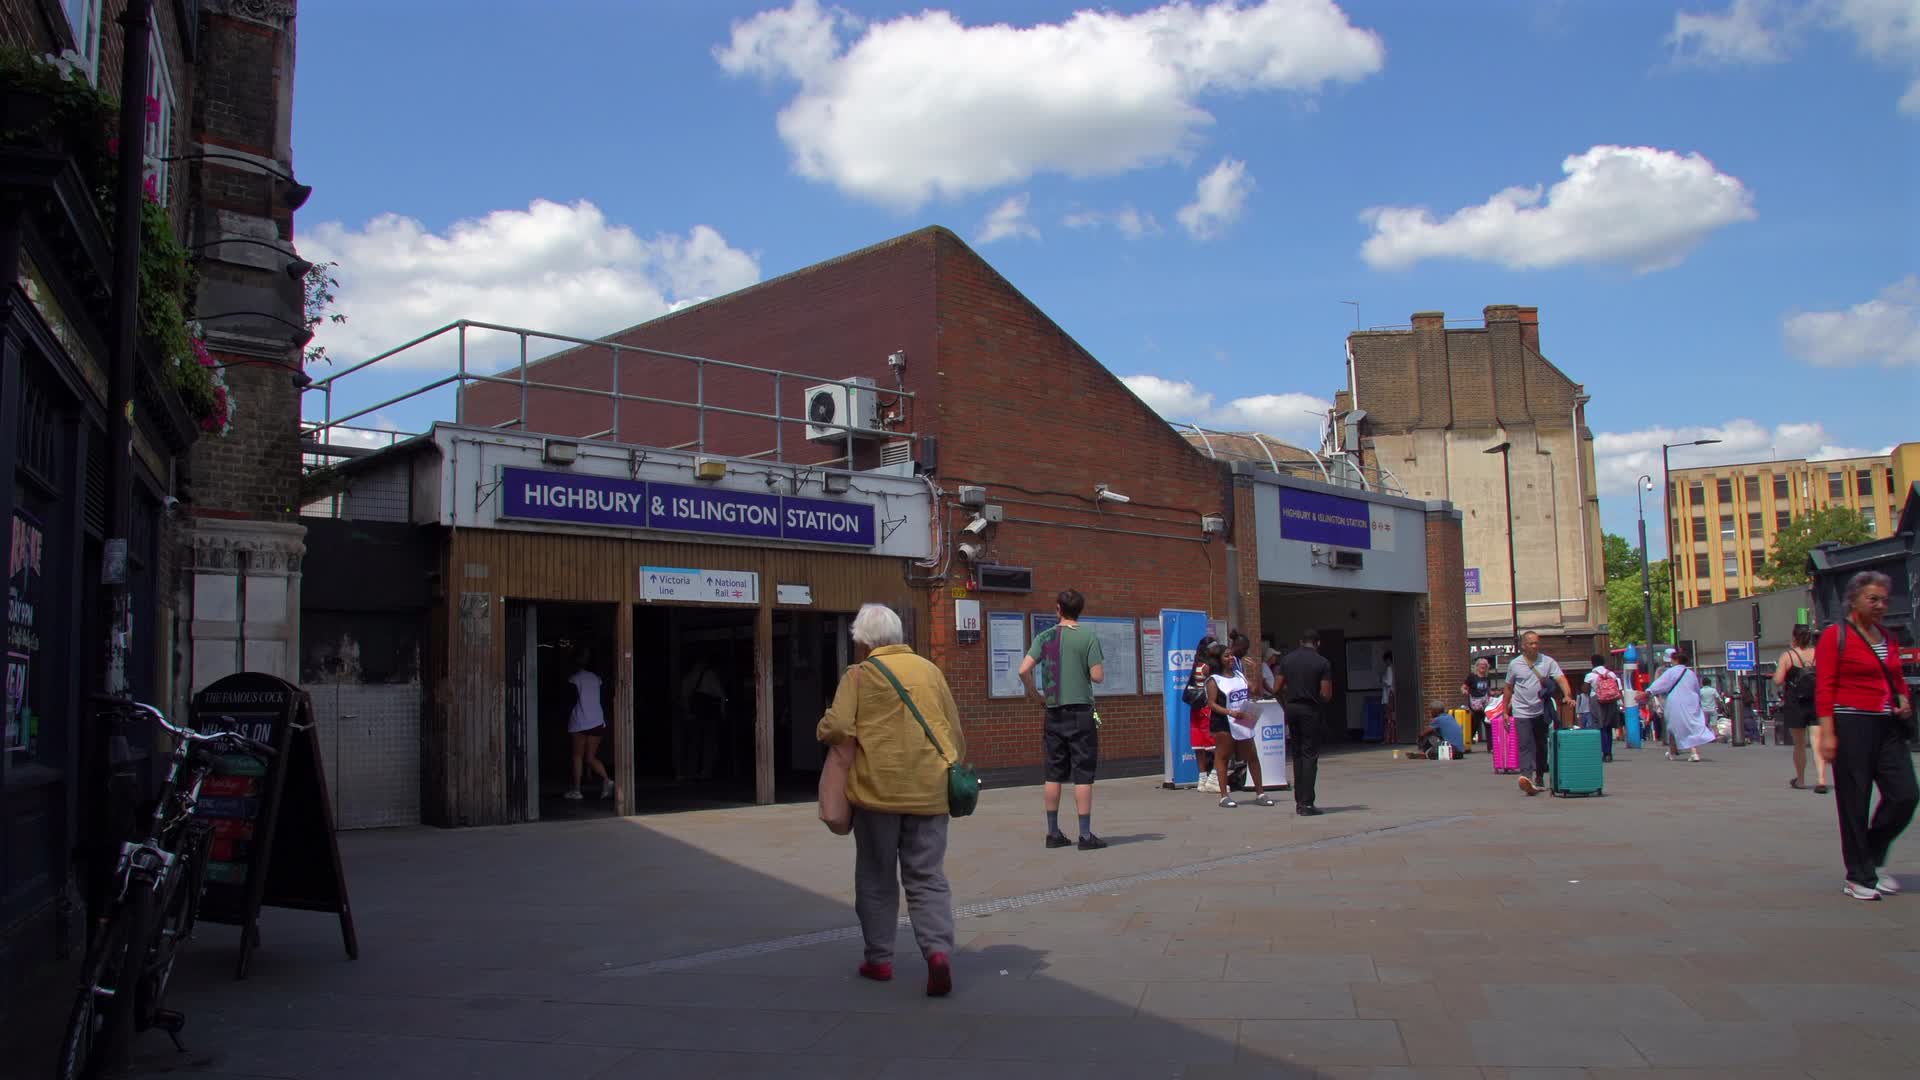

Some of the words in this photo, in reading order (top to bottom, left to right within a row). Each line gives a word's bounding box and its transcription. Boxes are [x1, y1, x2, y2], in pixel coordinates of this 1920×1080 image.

[524, 484, 641, 514] HIGHBURY
[651, 496, 664, 516] &
[672, 498, 777, 527] ISLINGTON
[787, 509, 859, 533] STATION
[1282, 508, 1311, 521] HIGHBURY
[1317, 514, 1346, 526] ISLINGTON
[1346, 518, 1368, 529] STATION
[659, 575, 690, 587] Victoria
[714, 577, 747, 590] National
[659, 585, 674, 596] line
[714, 587, 729, 598] Rail
[206, 691, 222, 704] THE
[222, 691, 258, 704] FAMOUS
[259, 691, 284, 704] COCK
[252, 722, 272, 743] ON
